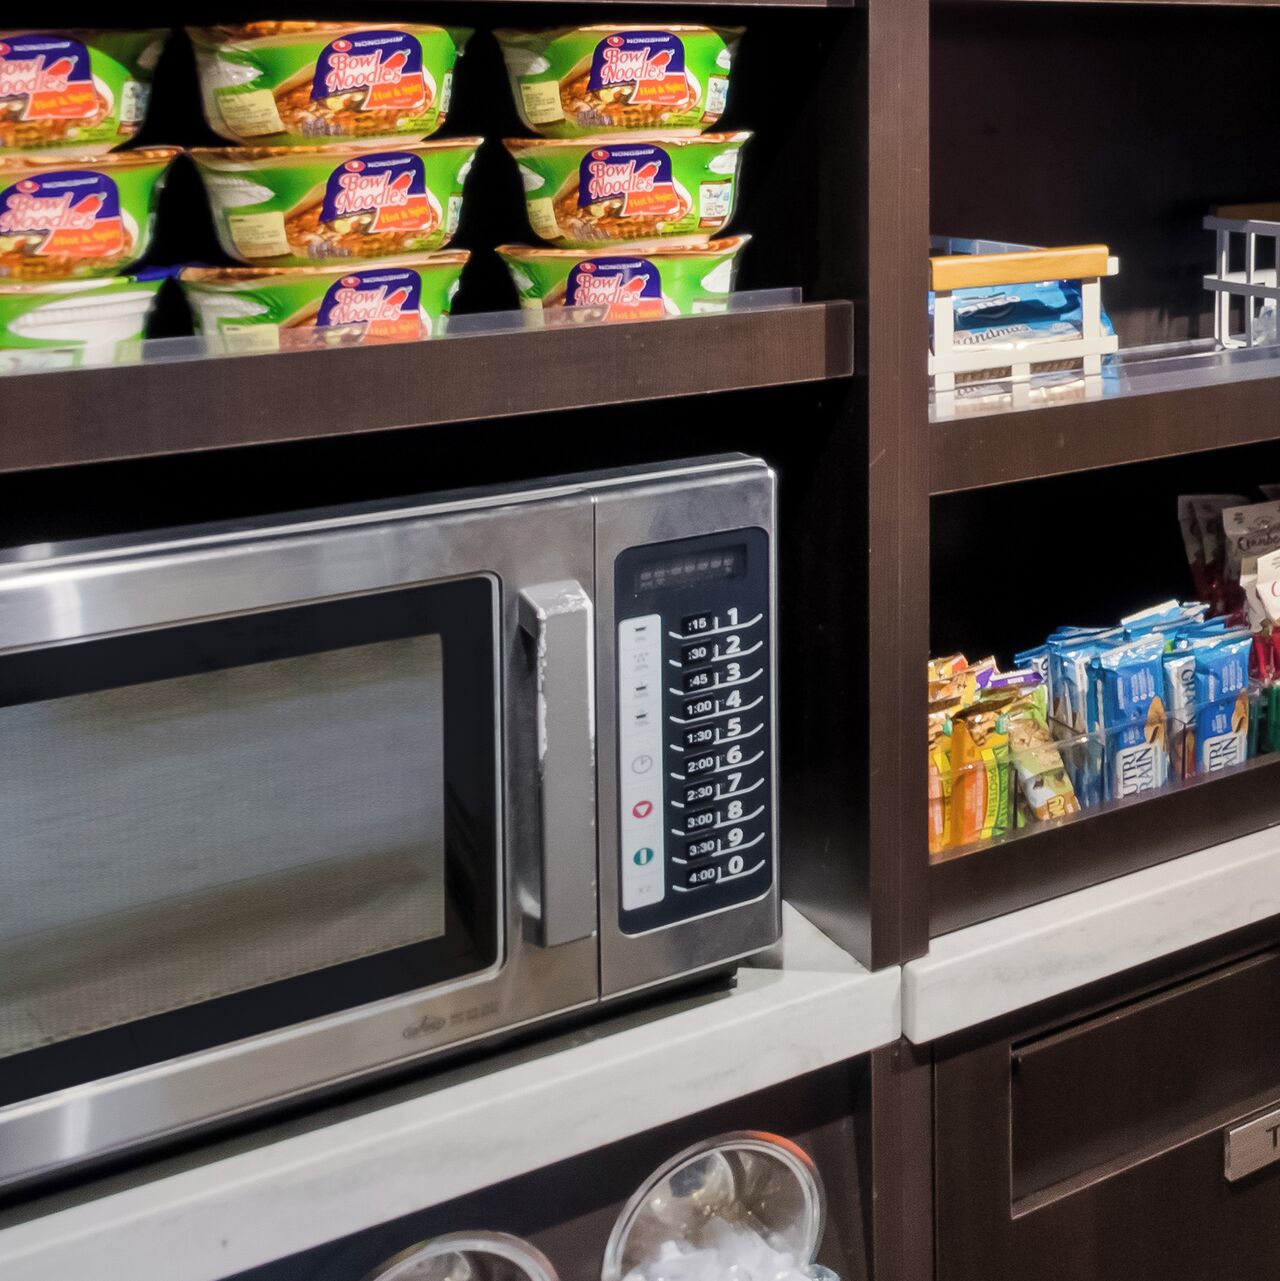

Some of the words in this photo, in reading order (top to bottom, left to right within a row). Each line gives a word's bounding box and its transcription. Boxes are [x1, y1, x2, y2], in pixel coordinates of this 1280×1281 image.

[354, 36, 404, 48] NONGSHIM
[329, 49, 382, 71] Bowl
[604, 47, 650, 66] Bowl
[326, 67, 402, 93] Noodles
[602, 62, 666, 84] Noodles
[372, 91, 393, 102] Hot
[639, 86, 658, 96] Hot
[612, 149, 655, 157] NONGSHIM
[589, 160, 636, 179] Bowl
[339, 170, 392, 194] Bowl
[589, 174, 654, 199] Noodles
[336, 190, 407, 215] Noodles
[629, 197, 647, 208] Hot
[380, 211, 400, 223] Hot
[577, 273, 622, 292] Bowl
[335, 285, 387, 310] Bowl
[575, 289, 640, 307] Noodles
[331, 305, 401, 328] Noodles
[688, 618, 707, 631] :15
[727, 607, 738, 625] 1
[688, 647, 707, 659] :30
[726, 635, 741, 654] 2
[689, 674, 708, 687] :45
[726, 662, 741, 682] 3
[686, 701, 712, 715] 1:00
[726, 690, 742, 708] 4
[687, 729, 712, 743] 1:30
[727, 717, 741, 737] 5
[688, 757, 713, 773] 2:00
[726, 745, 742, 764] 6
[687, 785, 713, 801] 2:30
[727, 772, 742, 792] 7
[987, 768, 999, 818] PROTEIN
[688, 813, 713, 828] 3:00
[727, 800, 743, 820] 8
[689, 841, 715, 856] 3:30
[727, 828, 743, 847] 9
[689, 868, 715, 883] 4:00
[728, 855, 744, 874] 0
